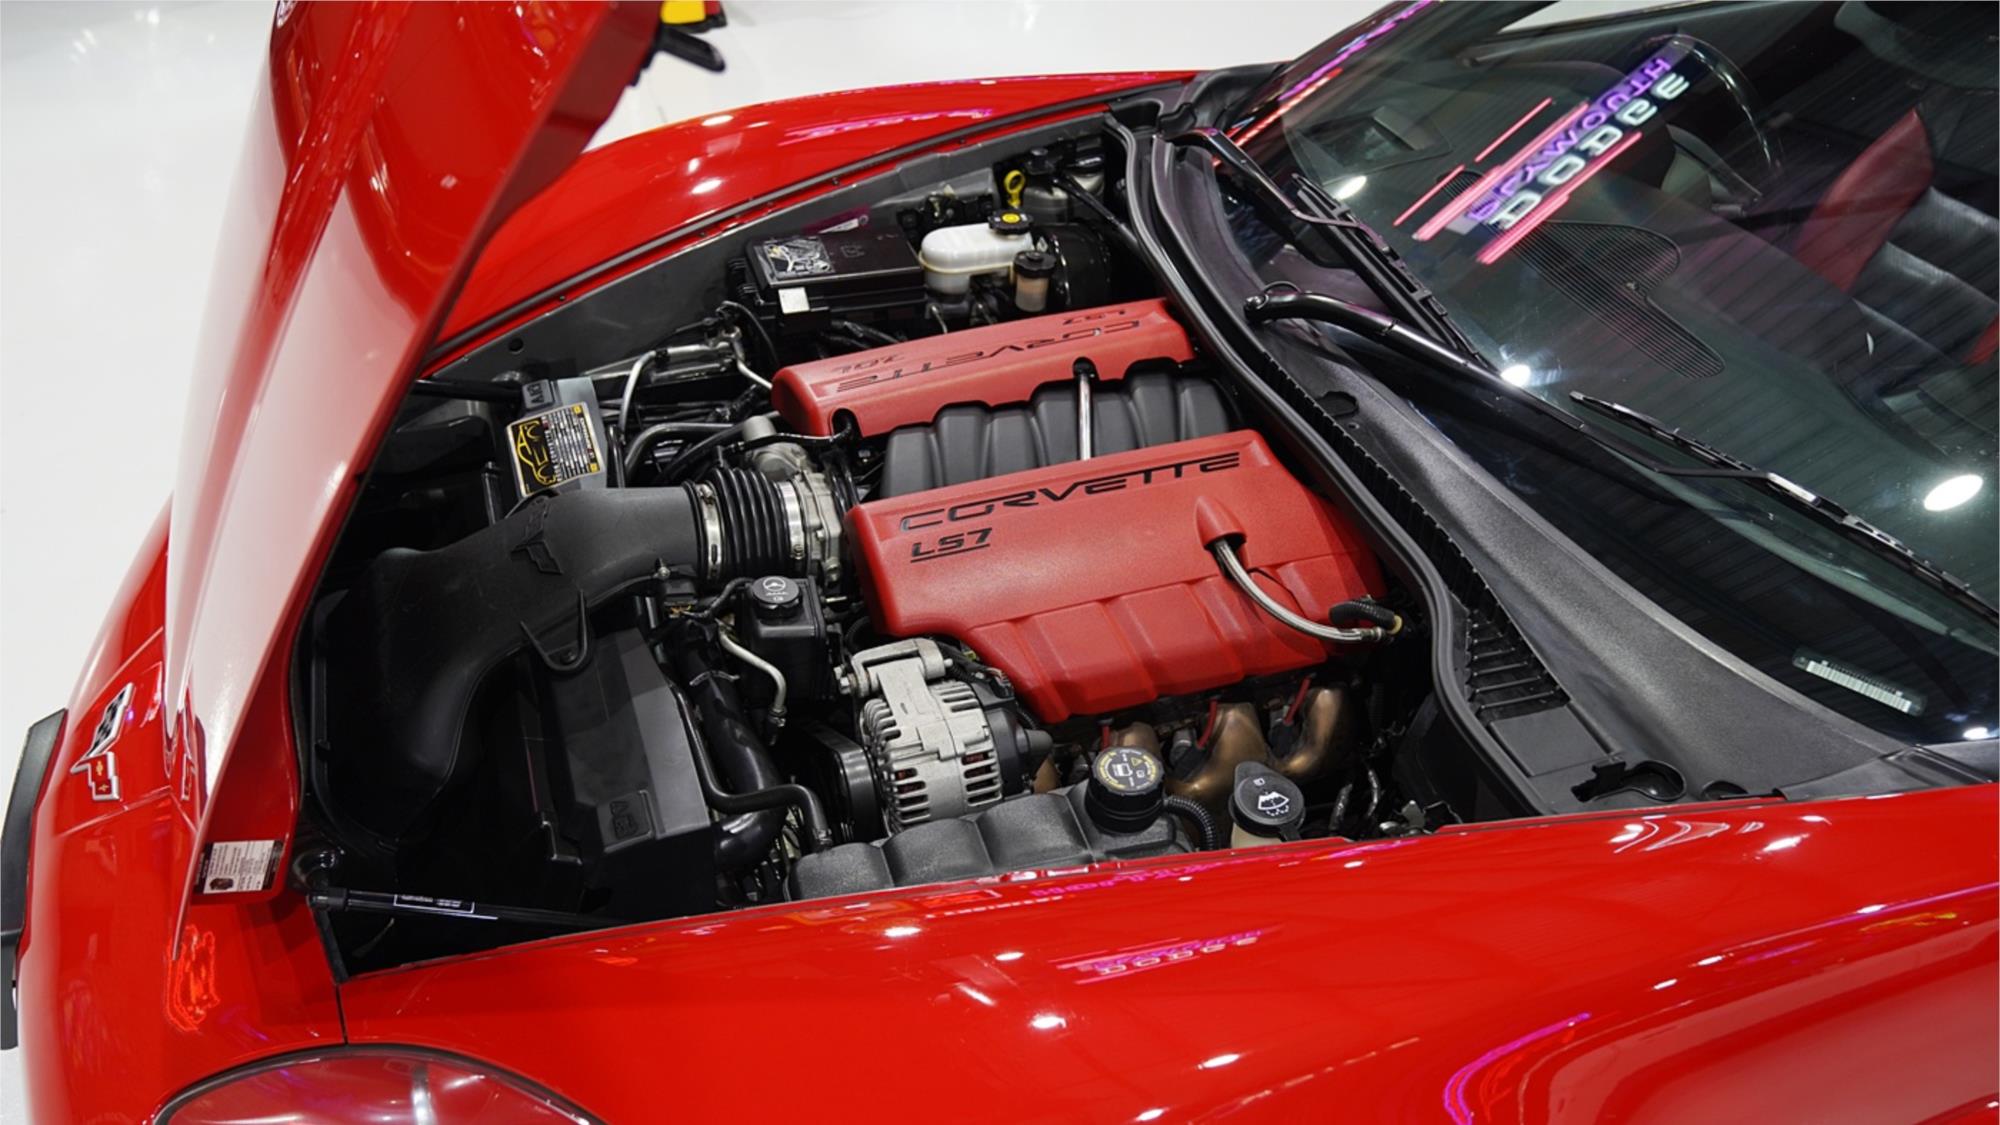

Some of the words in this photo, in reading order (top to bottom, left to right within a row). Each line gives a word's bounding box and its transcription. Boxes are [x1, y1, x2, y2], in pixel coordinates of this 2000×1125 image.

[1063, 309, 1126, 325] LS7
[836, 320, 1140, 392] CORVETTE
[900, 452, 1240, 531] CORVETTE
[911, 527, 993, 559] LS7
